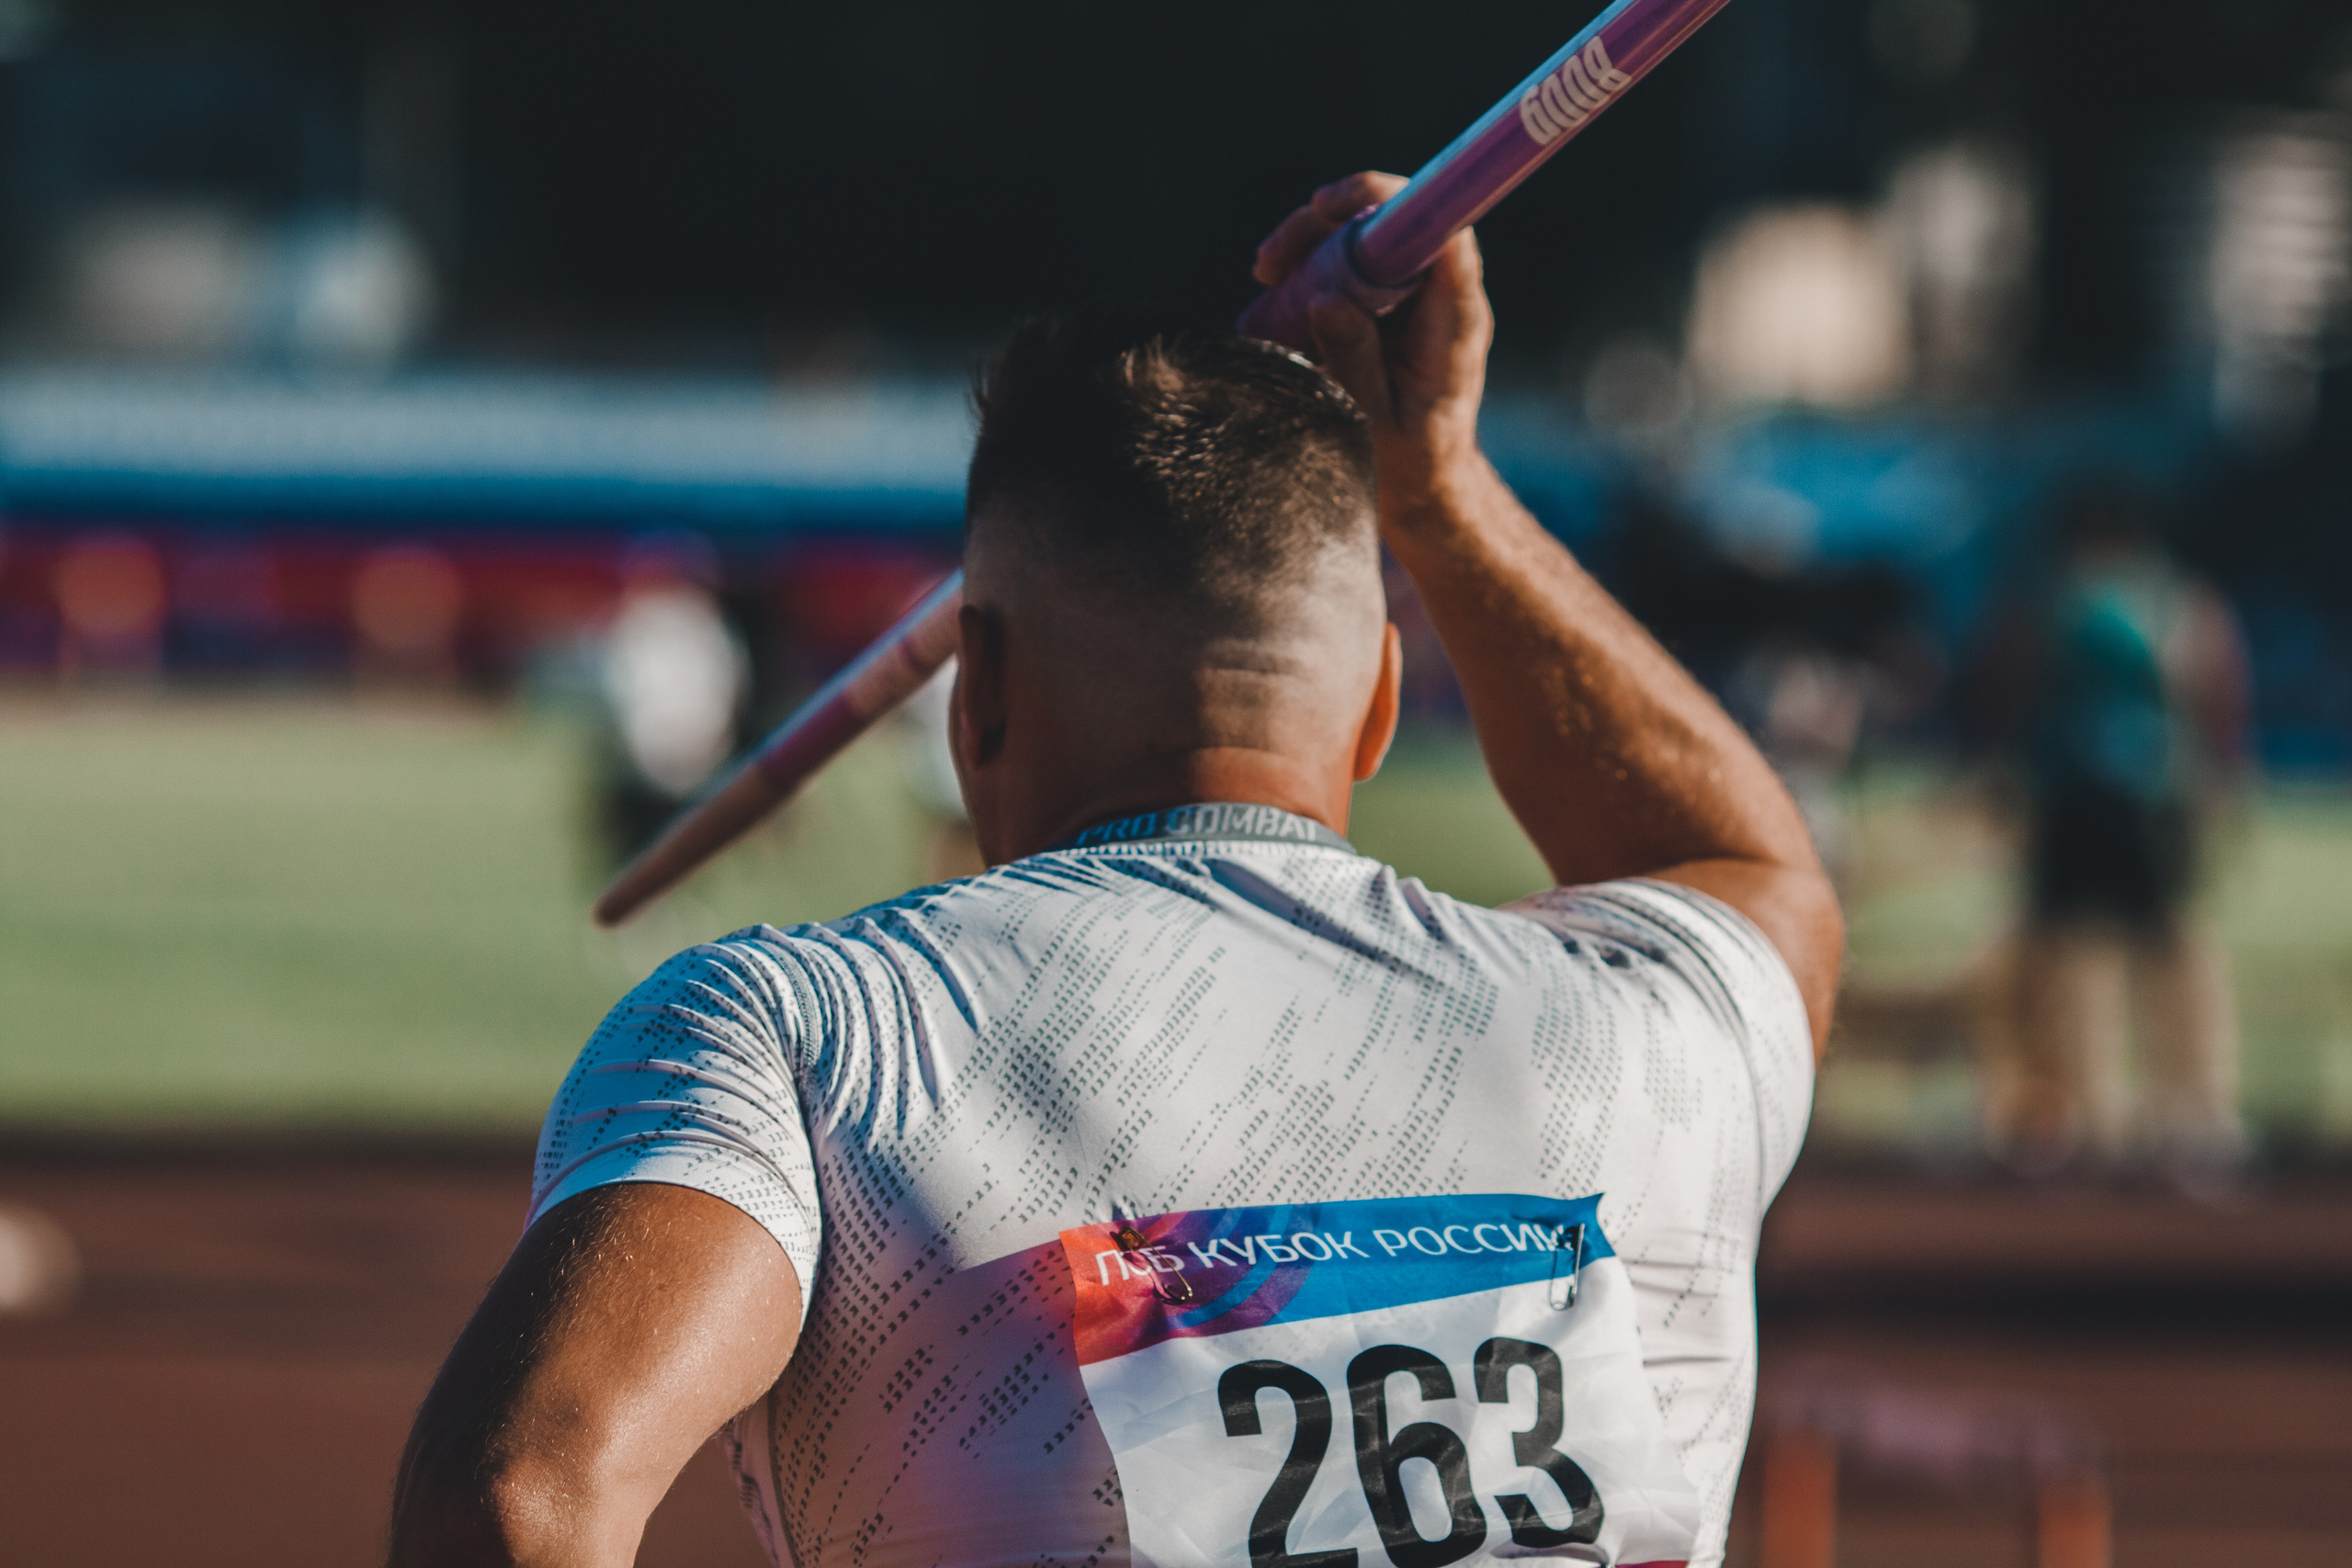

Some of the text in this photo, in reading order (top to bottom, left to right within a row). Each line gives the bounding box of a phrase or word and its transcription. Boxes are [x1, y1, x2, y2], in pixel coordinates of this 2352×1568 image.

[1076, 805, 1317, 845] PRO COMBAT
[1187, 1231, 1371, 1269] КУБОК
[1217, 1337, 1605, 1568] 263
